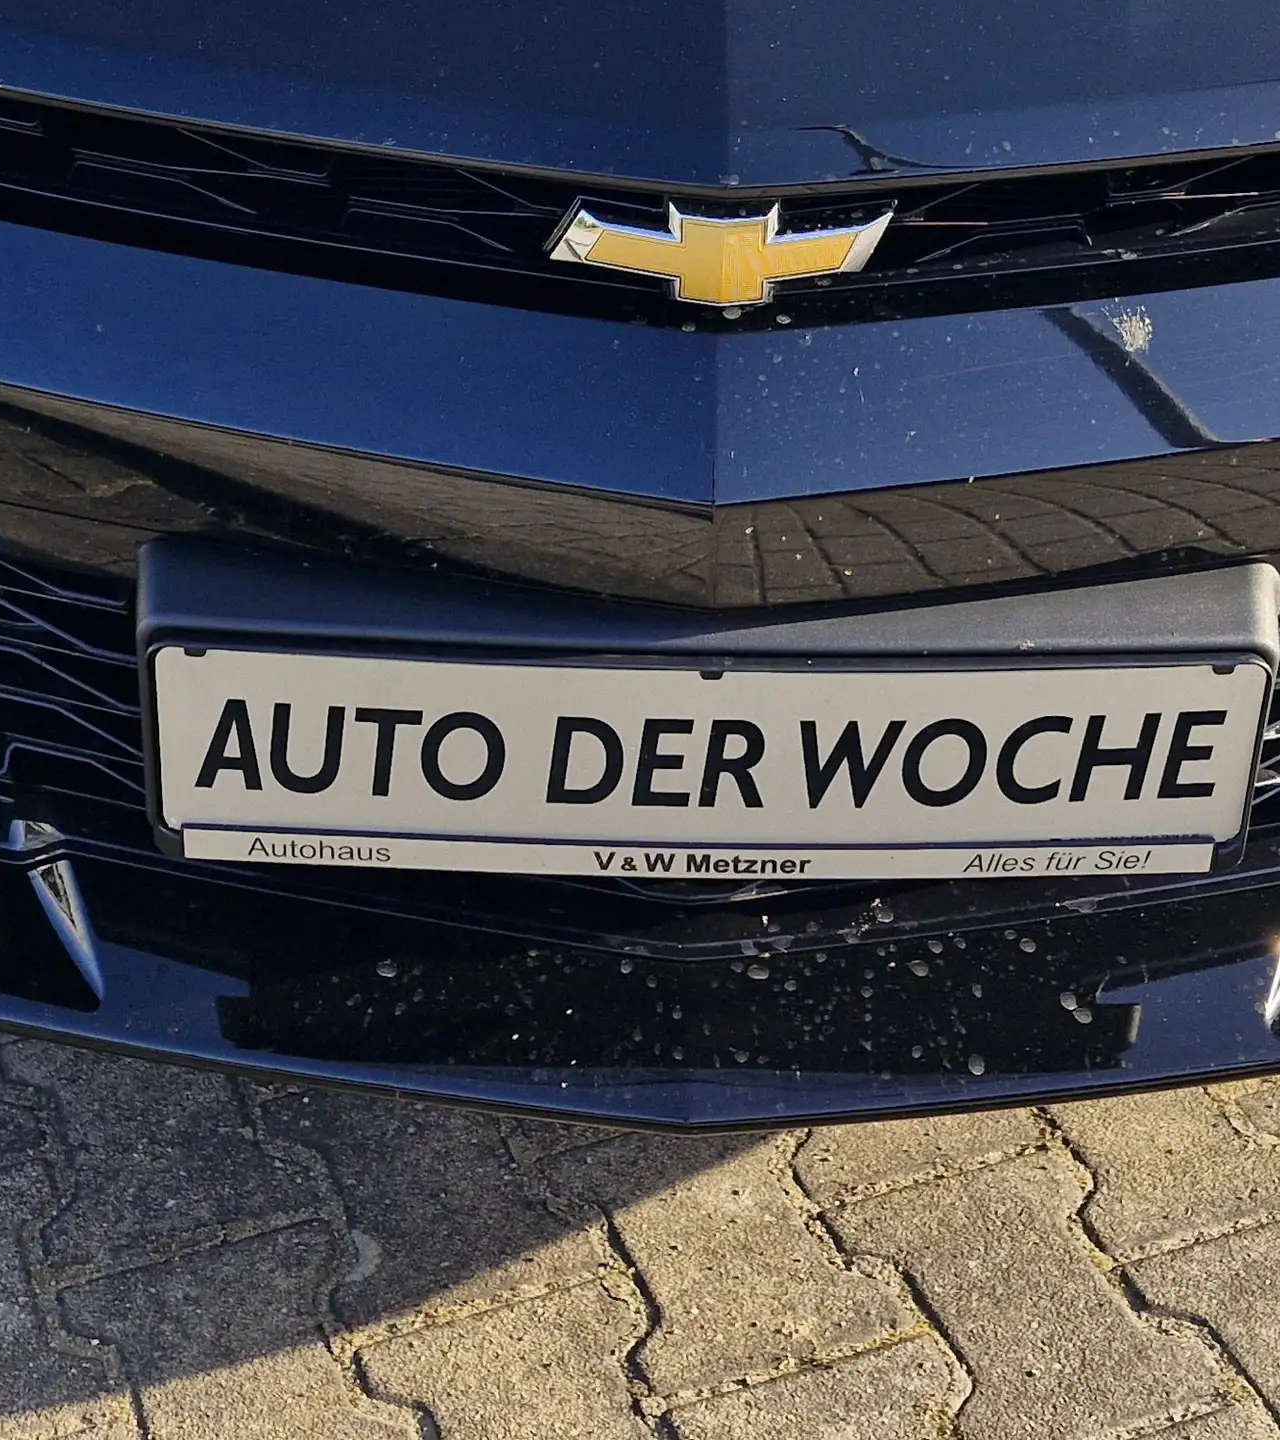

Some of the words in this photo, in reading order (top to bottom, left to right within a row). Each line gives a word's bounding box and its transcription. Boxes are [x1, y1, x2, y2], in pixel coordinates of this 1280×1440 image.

[195, 698, 506, 801] AUTO
[546, 716, 766, 809] DER
[800, 709, 1228, 809] WOCHE
[247, 837, 392, 863] Autohaus
[593, 851, 616, 871] V
[621, 857, 638, 872] &
[644, 853, 676, 873] W
[686, 854, 812, 874] Metzner
[963, 852, 1036, 874] Alles
[1044, 850, 1085, 872] für
[1094, 849, 1152, 871] Sie!
